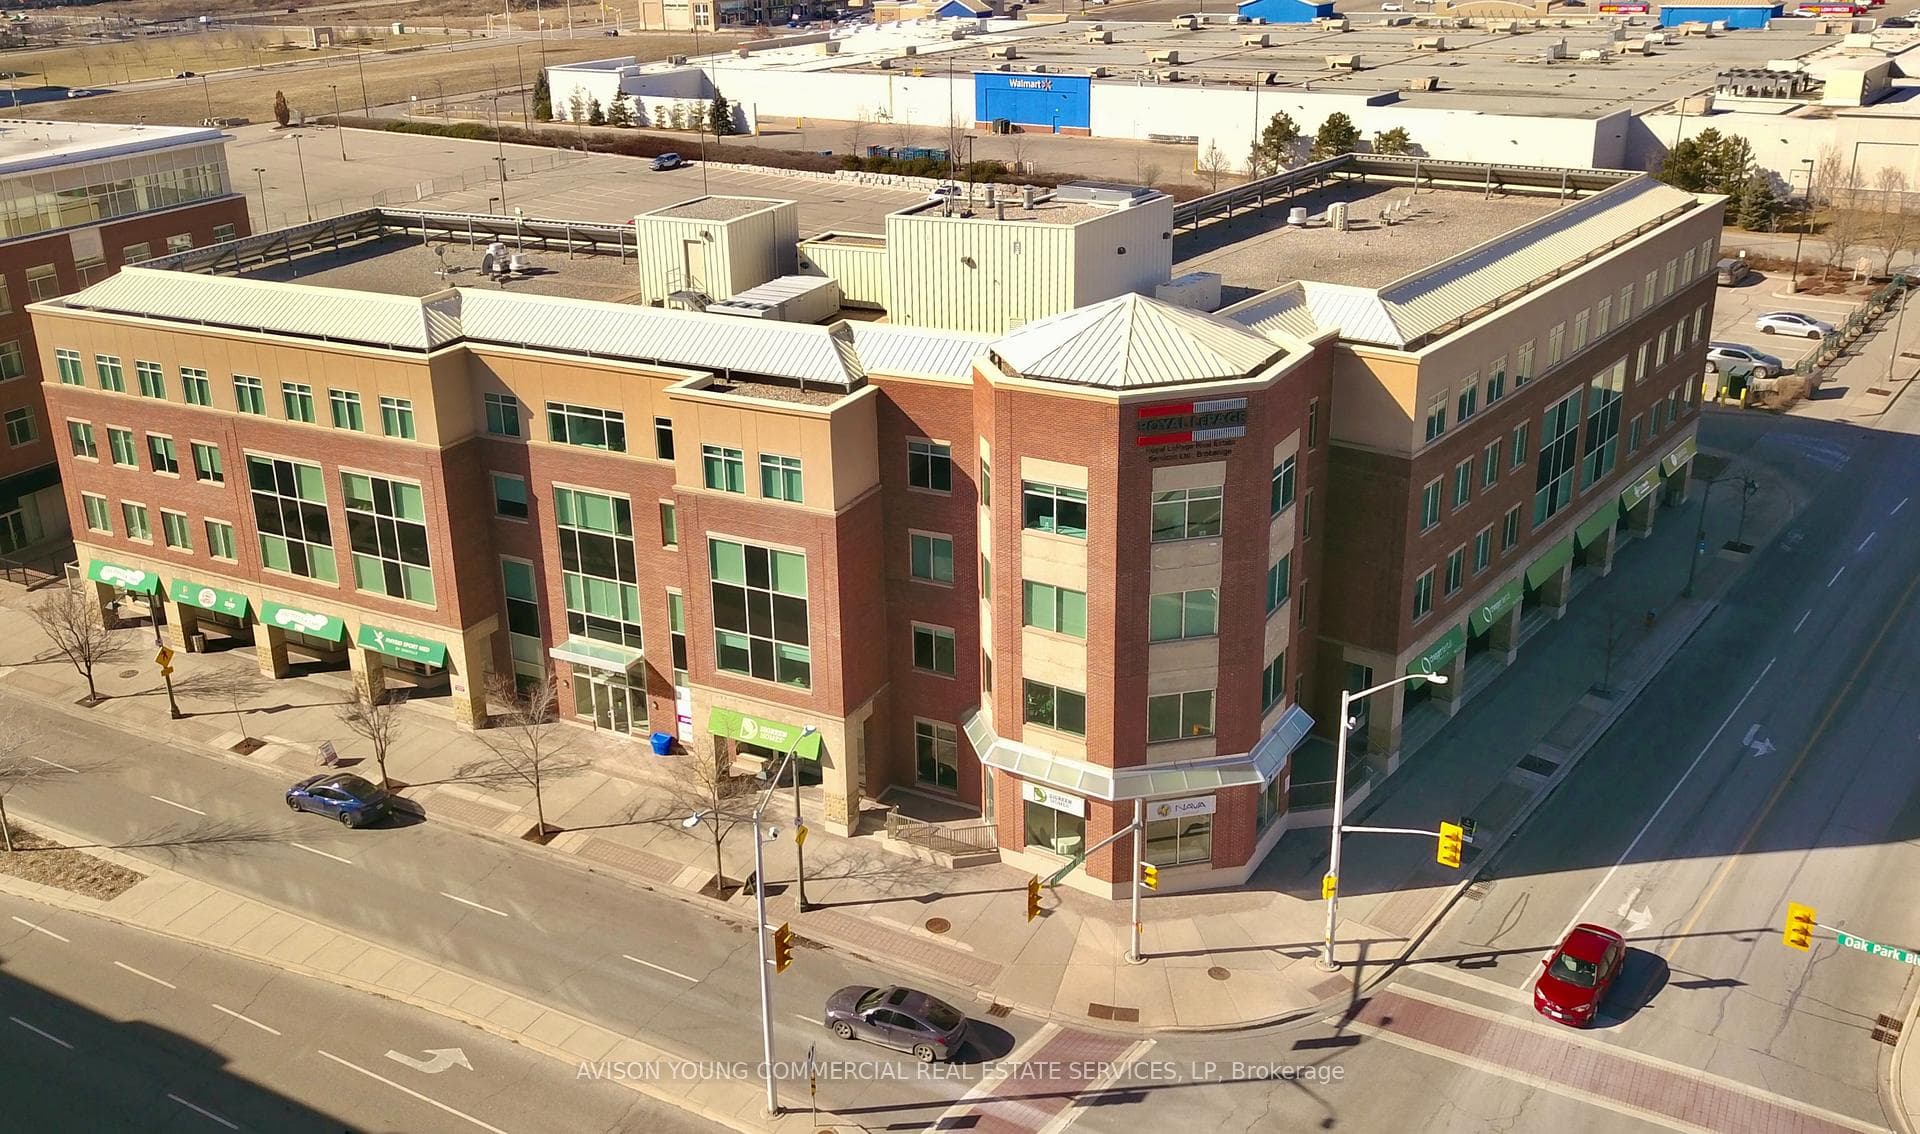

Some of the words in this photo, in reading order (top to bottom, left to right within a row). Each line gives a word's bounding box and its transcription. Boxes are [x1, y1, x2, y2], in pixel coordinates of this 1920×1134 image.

[1009, 78, 1041, 89] Walmart
[1175, 801, 1207, 812] NAVA
[1844, 937, 1869, 951] Oak
[1873, 944, 1901, 960] Park
